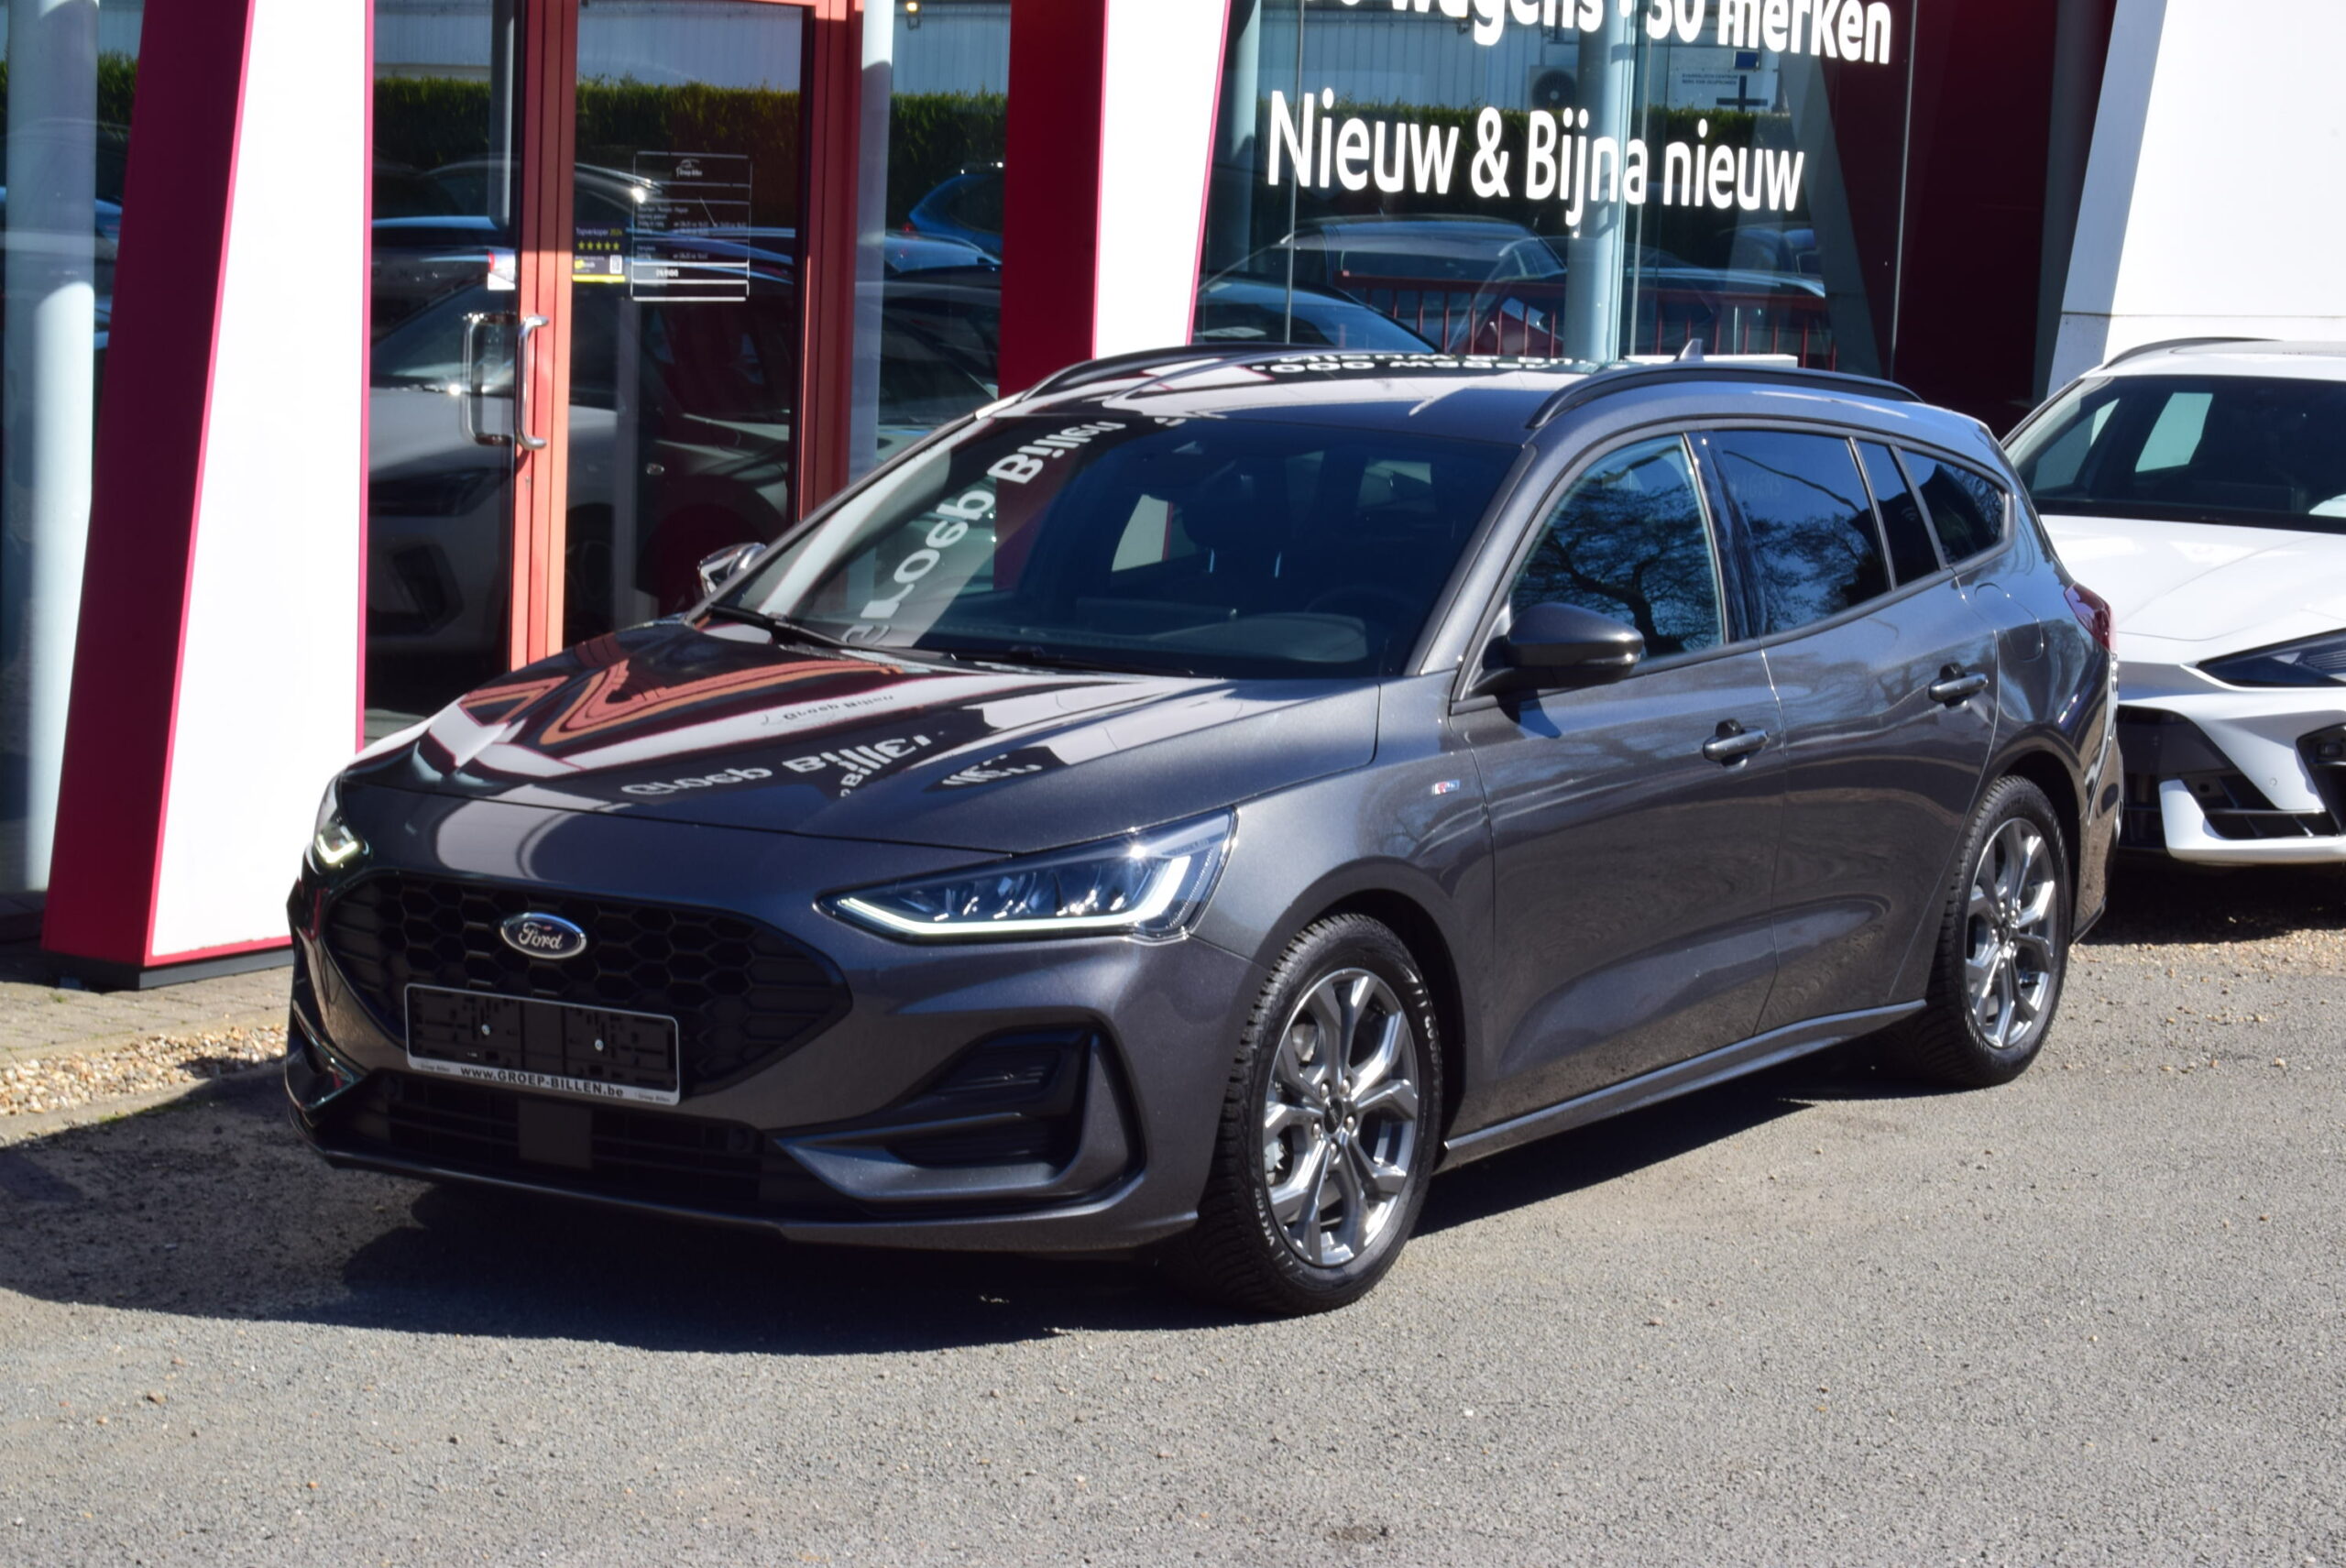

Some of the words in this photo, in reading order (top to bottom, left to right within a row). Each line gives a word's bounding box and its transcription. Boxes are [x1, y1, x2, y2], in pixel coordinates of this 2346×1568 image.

[1716, 0, 1891, 64] merken
[1268, 88, 1460, 194] Nieuw
[1470, 106, 1510, 198] &
[1527, 107, 1649, 226] Bijna
[1663, 119, 1804, 211] nieuw
[518, 921, 563, 950] Ford
[460, 1065, 624, 1098] www.GROEP-BILLEN.be
